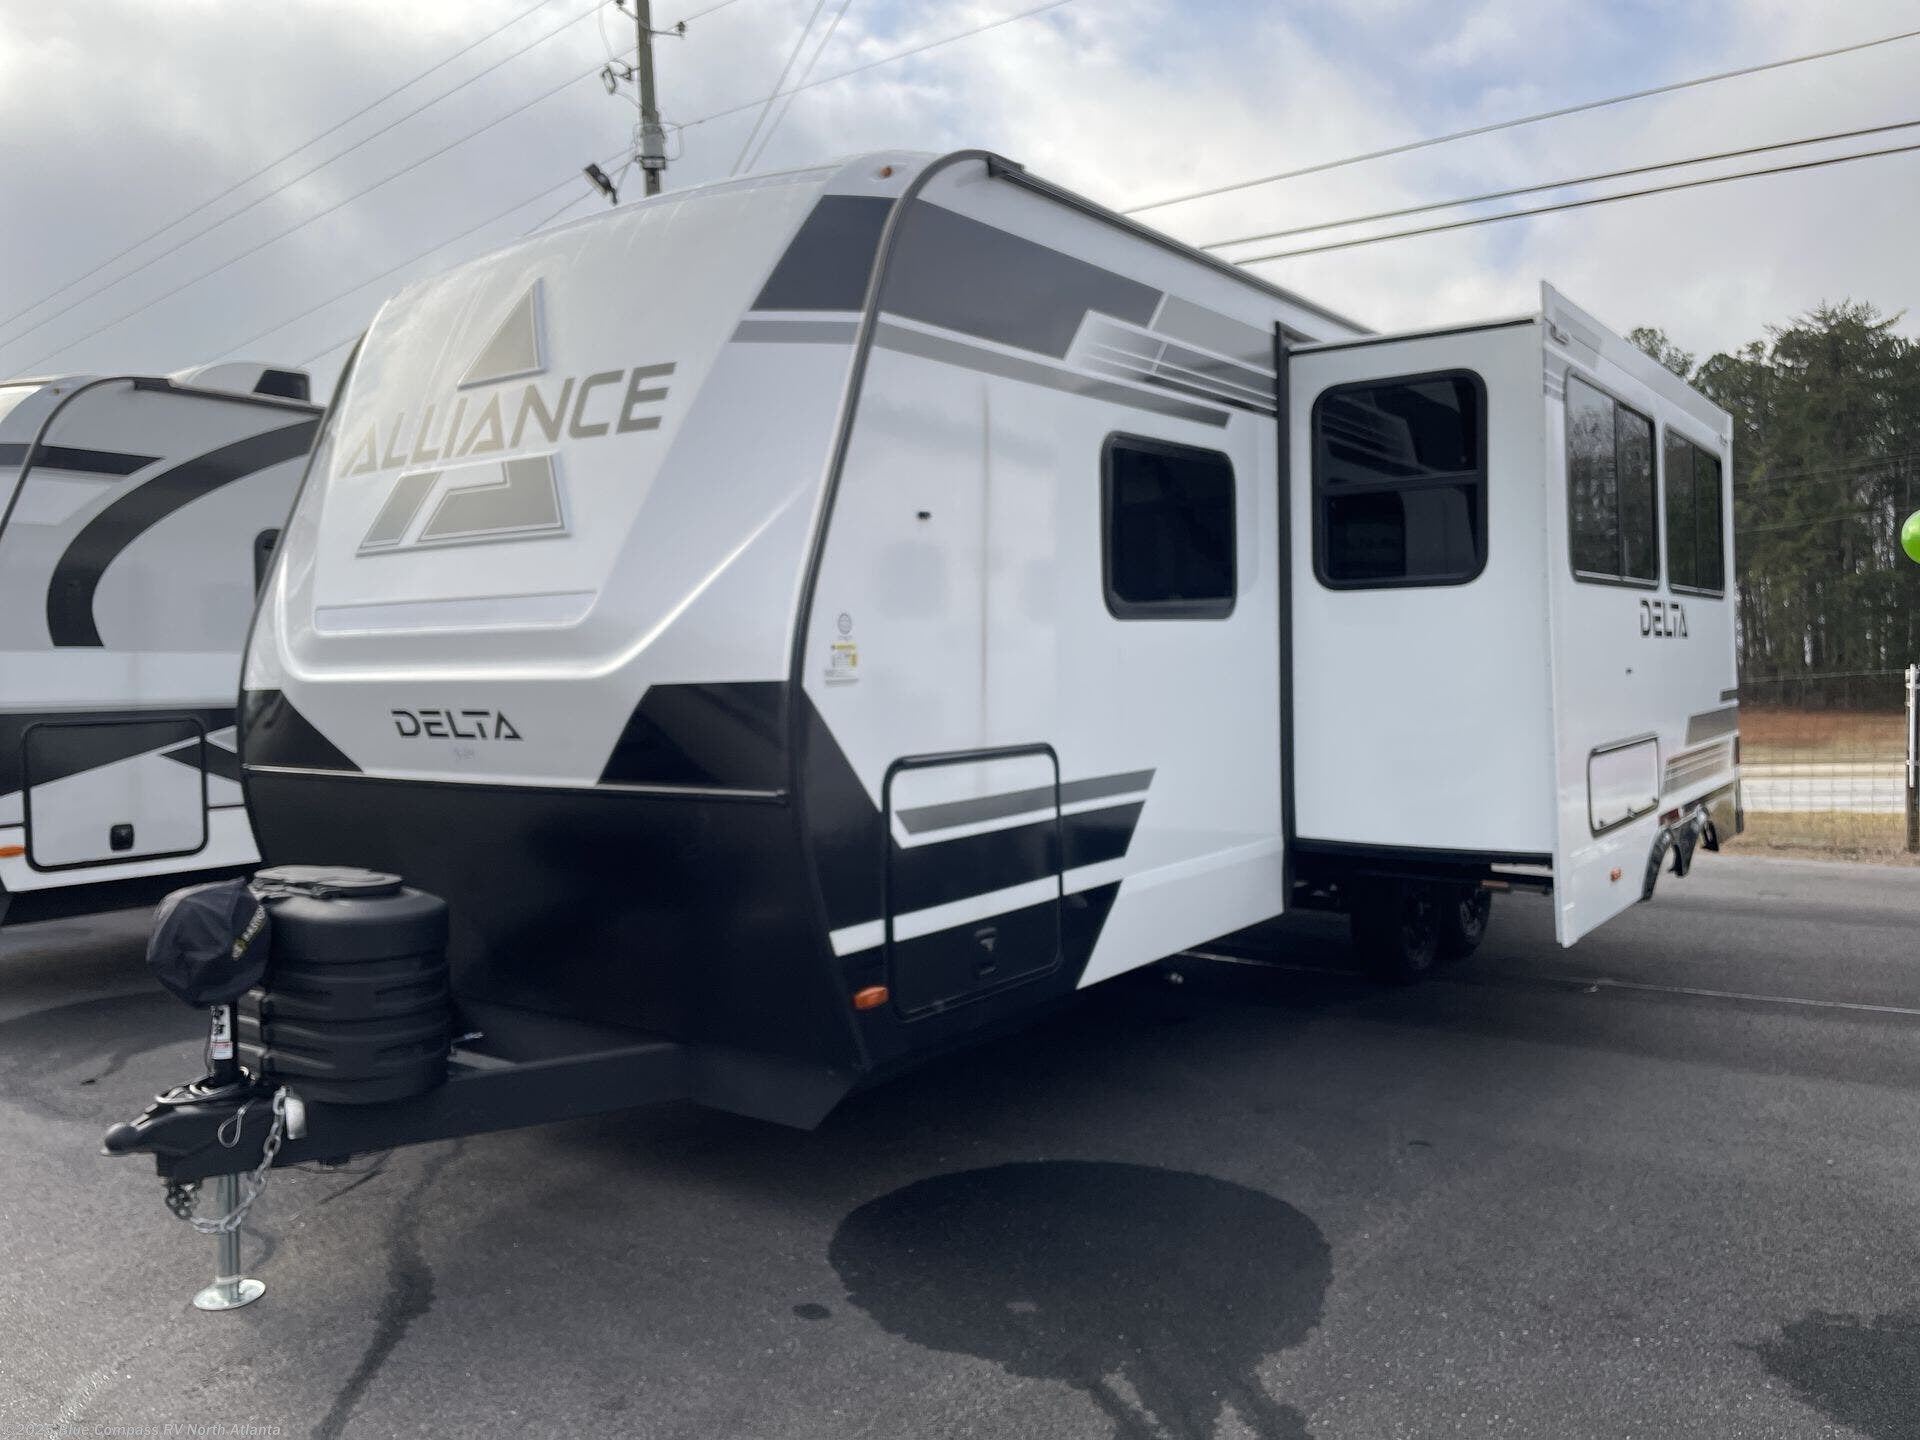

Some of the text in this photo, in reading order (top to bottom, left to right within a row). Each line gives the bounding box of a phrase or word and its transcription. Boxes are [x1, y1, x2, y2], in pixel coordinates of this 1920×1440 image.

[338, 360, 678, 478] ALLIANCE
[1640, 600, 1688, 637] DELTA
[391, 710, 522, 739] DELTA
